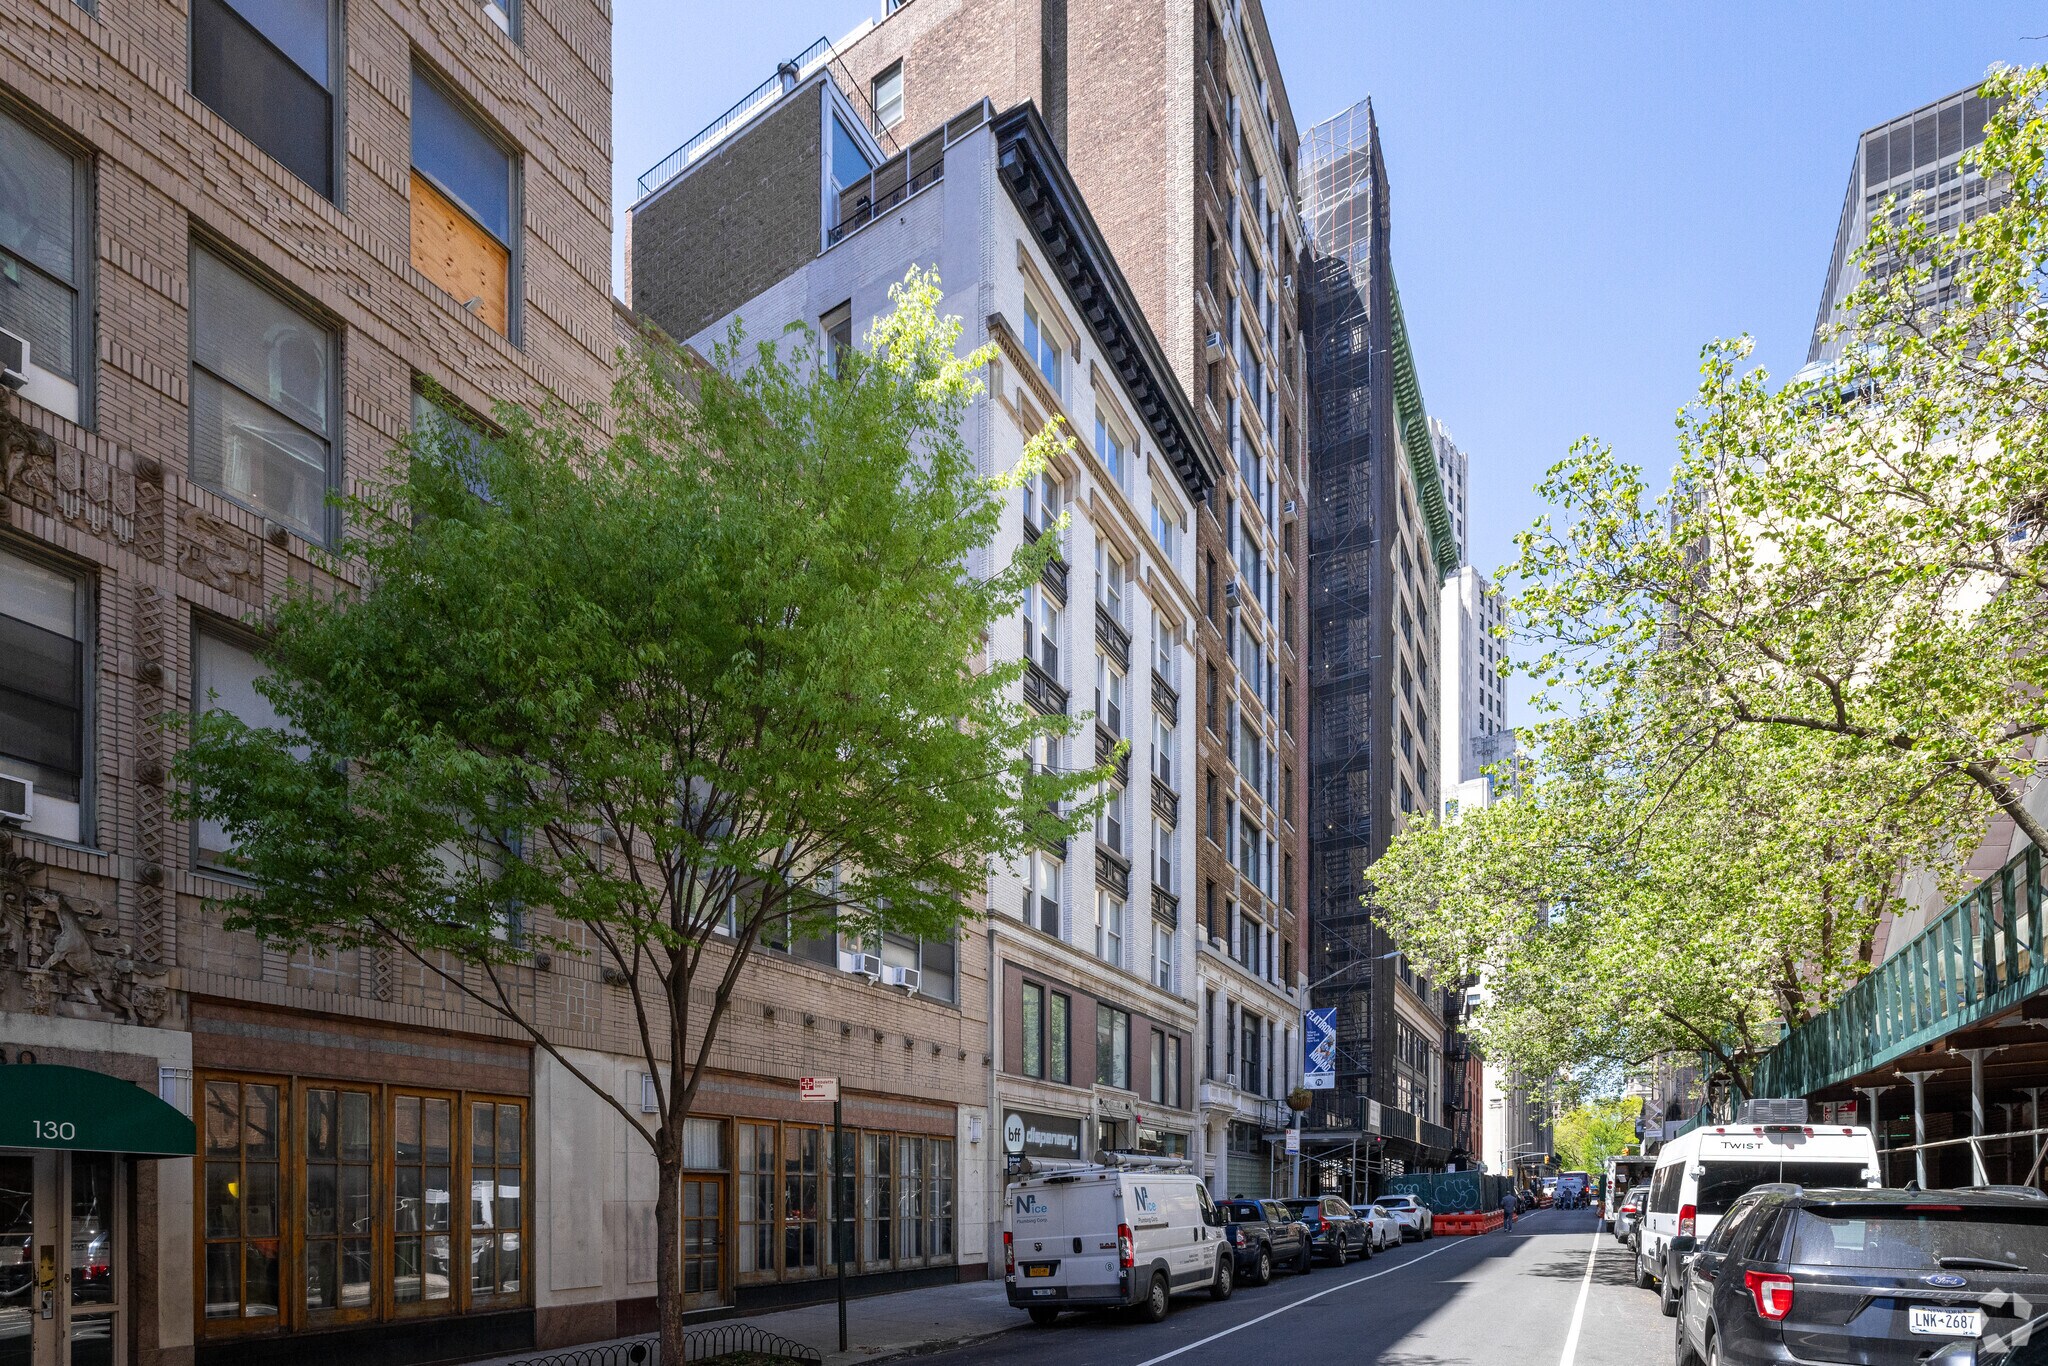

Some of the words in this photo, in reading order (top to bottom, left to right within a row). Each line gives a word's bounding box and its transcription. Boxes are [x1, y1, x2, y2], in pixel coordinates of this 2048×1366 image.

[1306, 1009, 1335, 1035] FLATIRON
[1309, 1052, 1331, 1073] NOMAD
[33, 1120, 76, 1141] 130
[1008, 1127, 1021, 1142] bff
[1016, 1194, 1048, 1214] Nice
[1134, 1186, 1157, 1212] Nice
[1935, 1275, 1958, 1285] Ford
